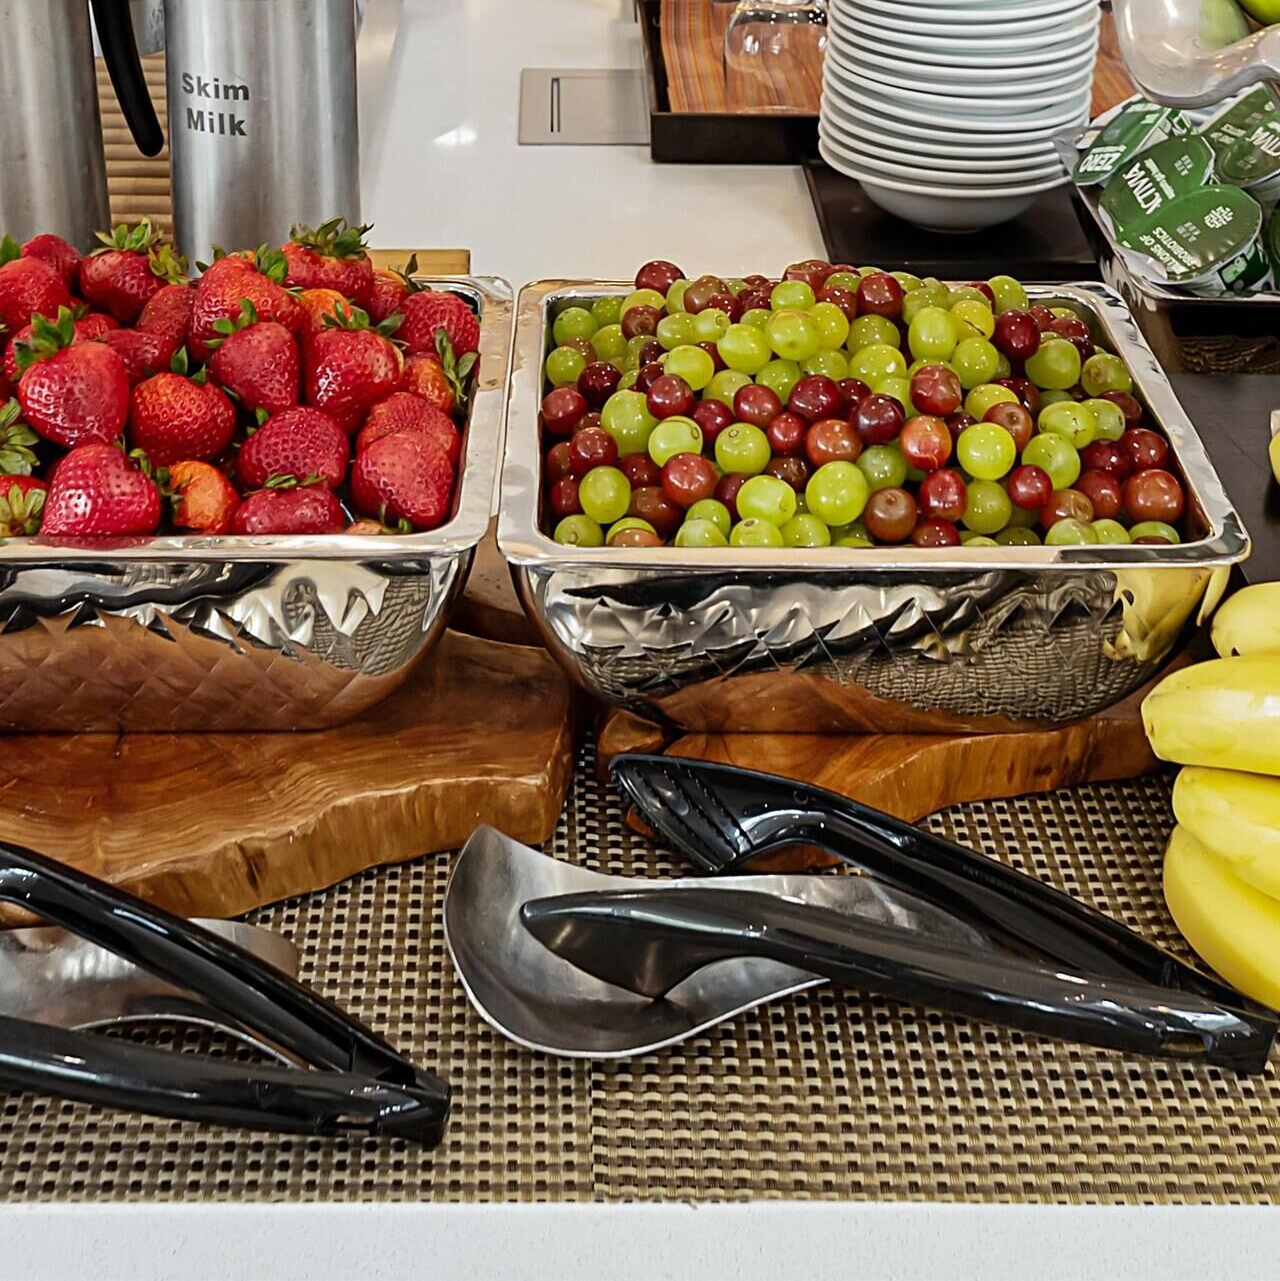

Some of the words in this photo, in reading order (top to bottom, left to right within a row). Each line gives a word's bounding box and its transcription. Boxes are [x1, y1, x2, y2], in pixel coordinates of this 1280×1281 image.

[182, 72, 250, 101] Skim
[186, 107, 248, 137] Milk
[1079, 152, 1121, 174] ZERO
[1139, 234, 1155, 246] OF
